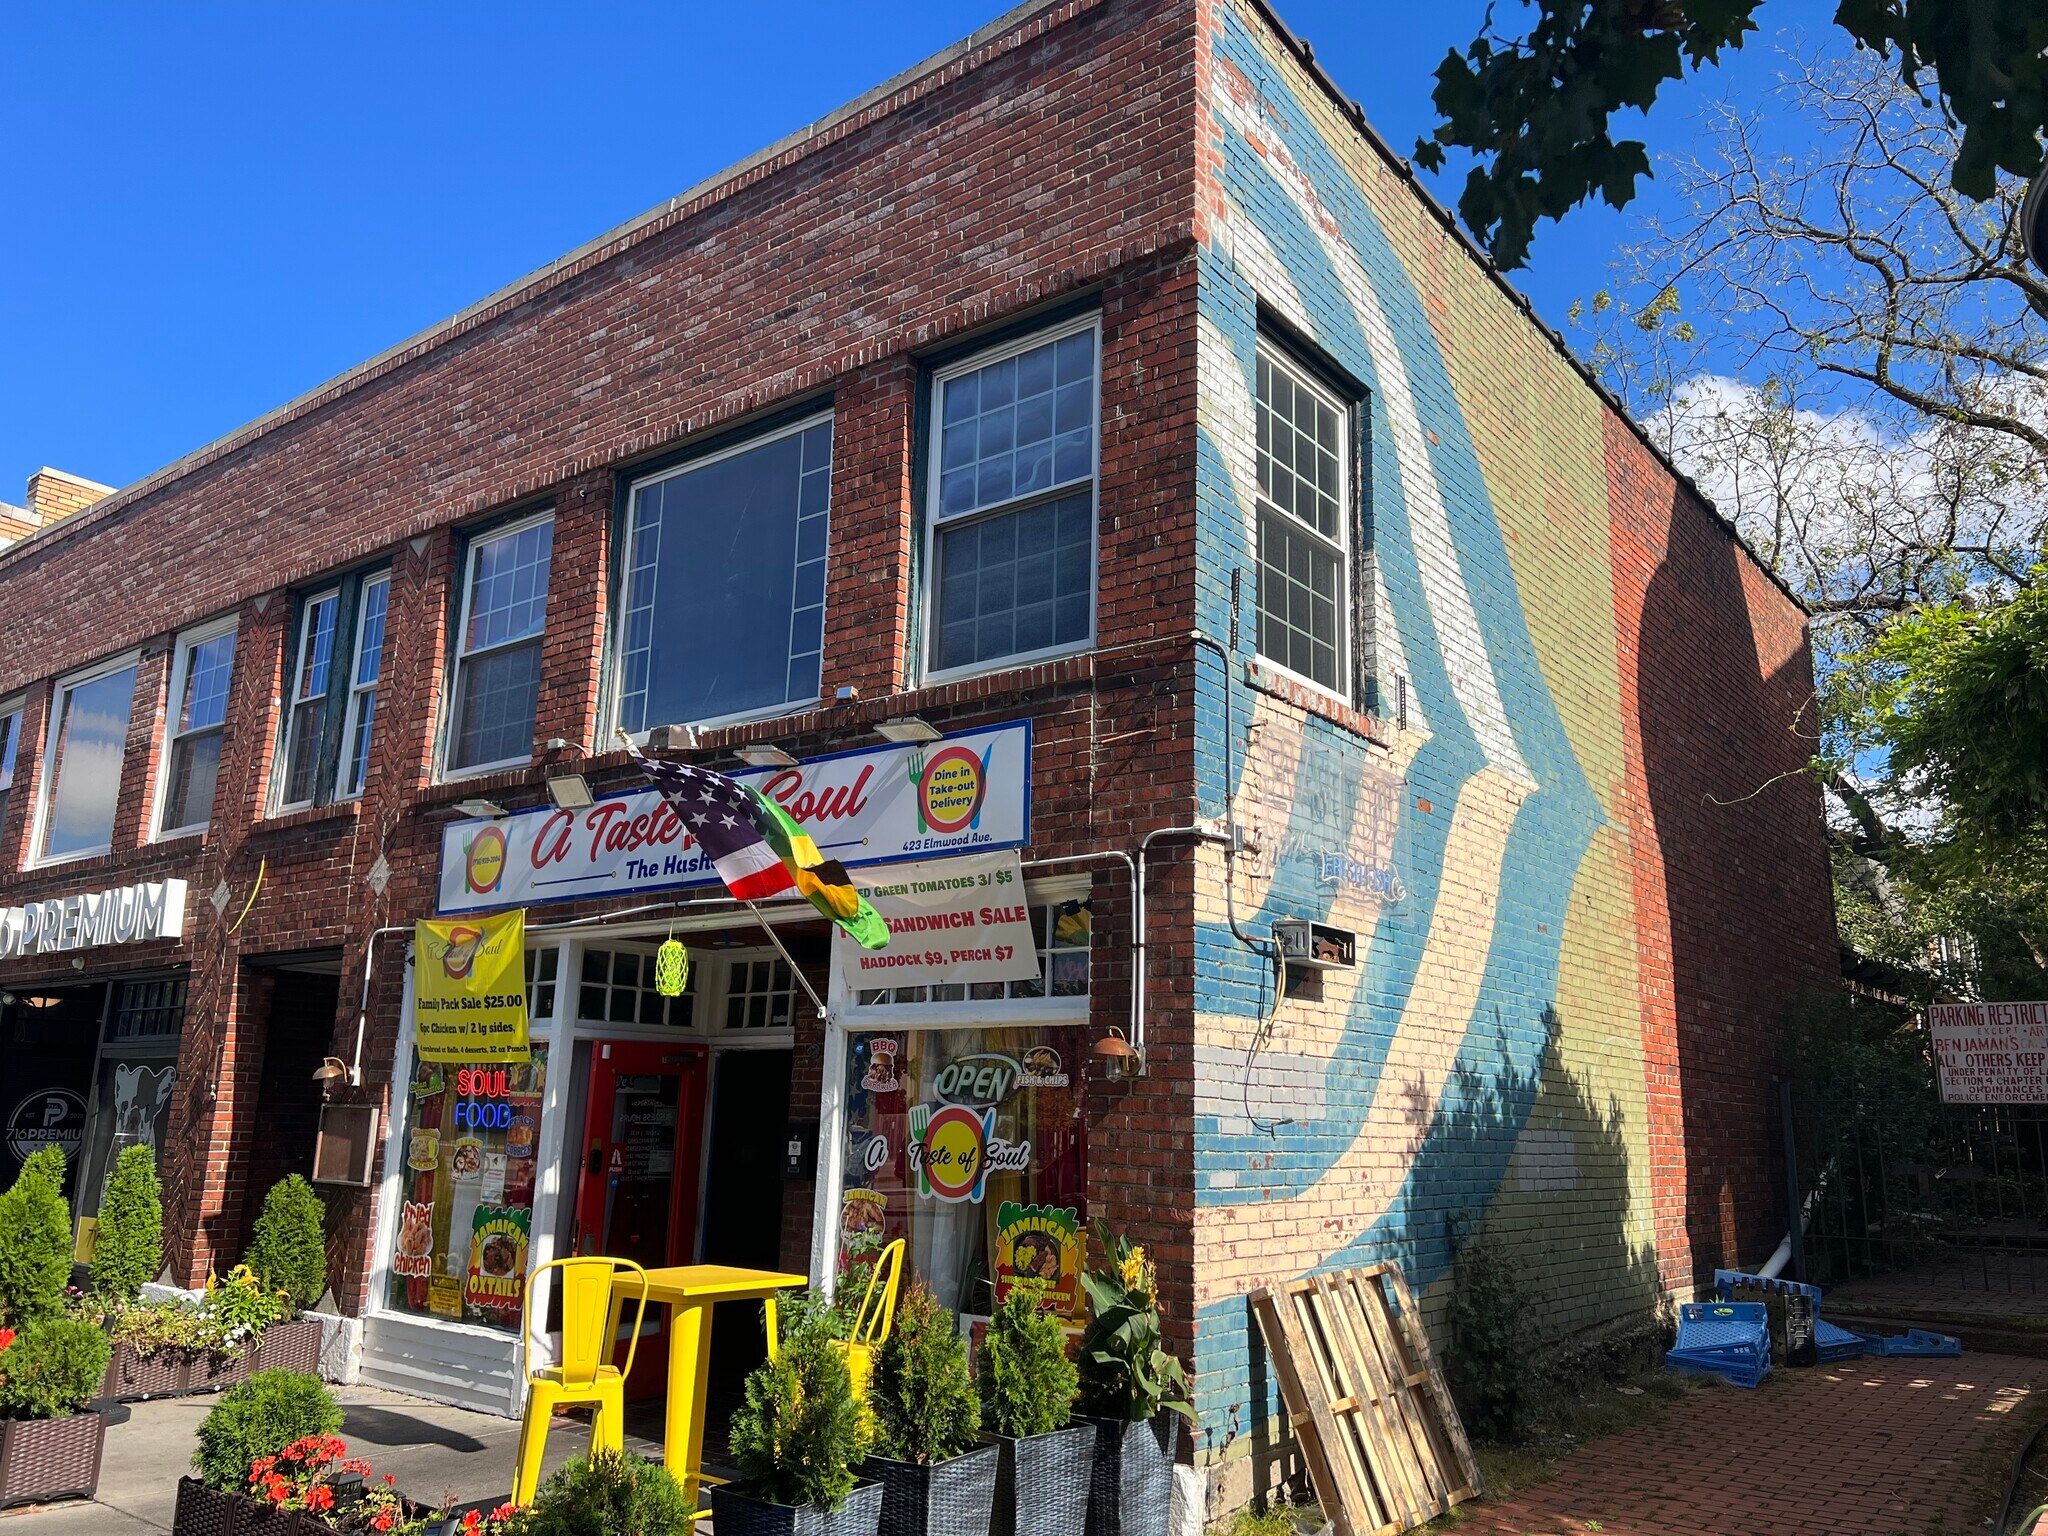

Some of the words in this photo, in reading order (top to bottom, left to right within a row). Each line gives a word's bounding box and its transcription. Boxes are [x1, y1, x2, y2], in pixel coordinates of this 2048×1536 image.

[934, 769, 958, 781] Dine
[960, 767, 970, 777] in
[929, 780, 975, 796] Take-out
[930, 795, 973, 810] Delivery
[531, 810, 574, 869] A
[586, 800, 683, 863] Taste
[761, 764, 875, 825] Soul
[902, 840, 922, 852] 423
[923, 833, 970, 849] Elmwood
[971, 832, 993, 843] Ave.
[626, 858, 659, 880] The
[663, 850, 717, 876] Hash
[874, 884, 909, 898] GREEN
[911, 874, 975, 894] TOMATOES
[977, 872, 992, 886] 3/
[995, 870, 1013, 887] $5
[17, 879, 180, 956] PREMIUM
[979, 905, 1027, 926] SALE
[474, 937, 503, 959] Soul
[860, 954, 923, 970] HADDOCK
[924, 951, 948, 967] $9,
[951, 948, 992, 963] PERCH
[995, 945, 1013, 962] $7
[418, 998, 440, 1012] Family
[441, 998, 459, 1009] Pack
[461, 997, 481, 1009] Sale
[483, 994, 523, 1010] $25.00
[1931, 1006, 1985, 1027] PARKING
[431, 1023, 457, 1034] Chicken
[458, 1022, 469, 1035] w/
[471, 1022, 477, 1033] 2
[478, 1022, 487, 1035] lg
[489, 1021, 516, 1034] sides,
[1977, 1026, 2018, 1036] EXCEPT
[490, 1045, 497, 1053] 32
[507, 1044, 528, 1053] Punch
[872, 1041, 896, 1053] BBQ
[1965, 1053, 2013, 1068] OTHERS
[2016, 1052, 2046, 1067] KEEP
[1017, 1075, 1034, 1085] FISH
[1035, 1075, 1042, 1084] &
[1044, 1075, 1068, 1085] CHIPS
[1945, 1076, 1984, 1086] SECTION
[1996, 1076, 2043, 1085] CHAPTER
[1948, 1068, 1976, 1077] UNDER
[2023, 1067, 2035, 1076] OF
[457, 1069, 511, 1098] SOUL
[938, 1064, 1012, 1102] OPEN
[1968, 1085, 2043, 1094] ORDINANCES
[455, 1102, 511, 1128] FOOD
[867, 1139, 886, 1167] A
[910, 1142, 953, 1169] Taste
[957, 1146, 976, 1174] of
[981, 1142, 1028, 1170] Soul
[473, 1218, 529, 1252] JAMAICAN
[1001, 1216, 1077, 1252] JAMAICAN
[393, 1252, 431, 1275] chicken
[469, 1275, 521, 1298] OXTAILS
[1043, 1290, 1071, 1302] HICKEN
